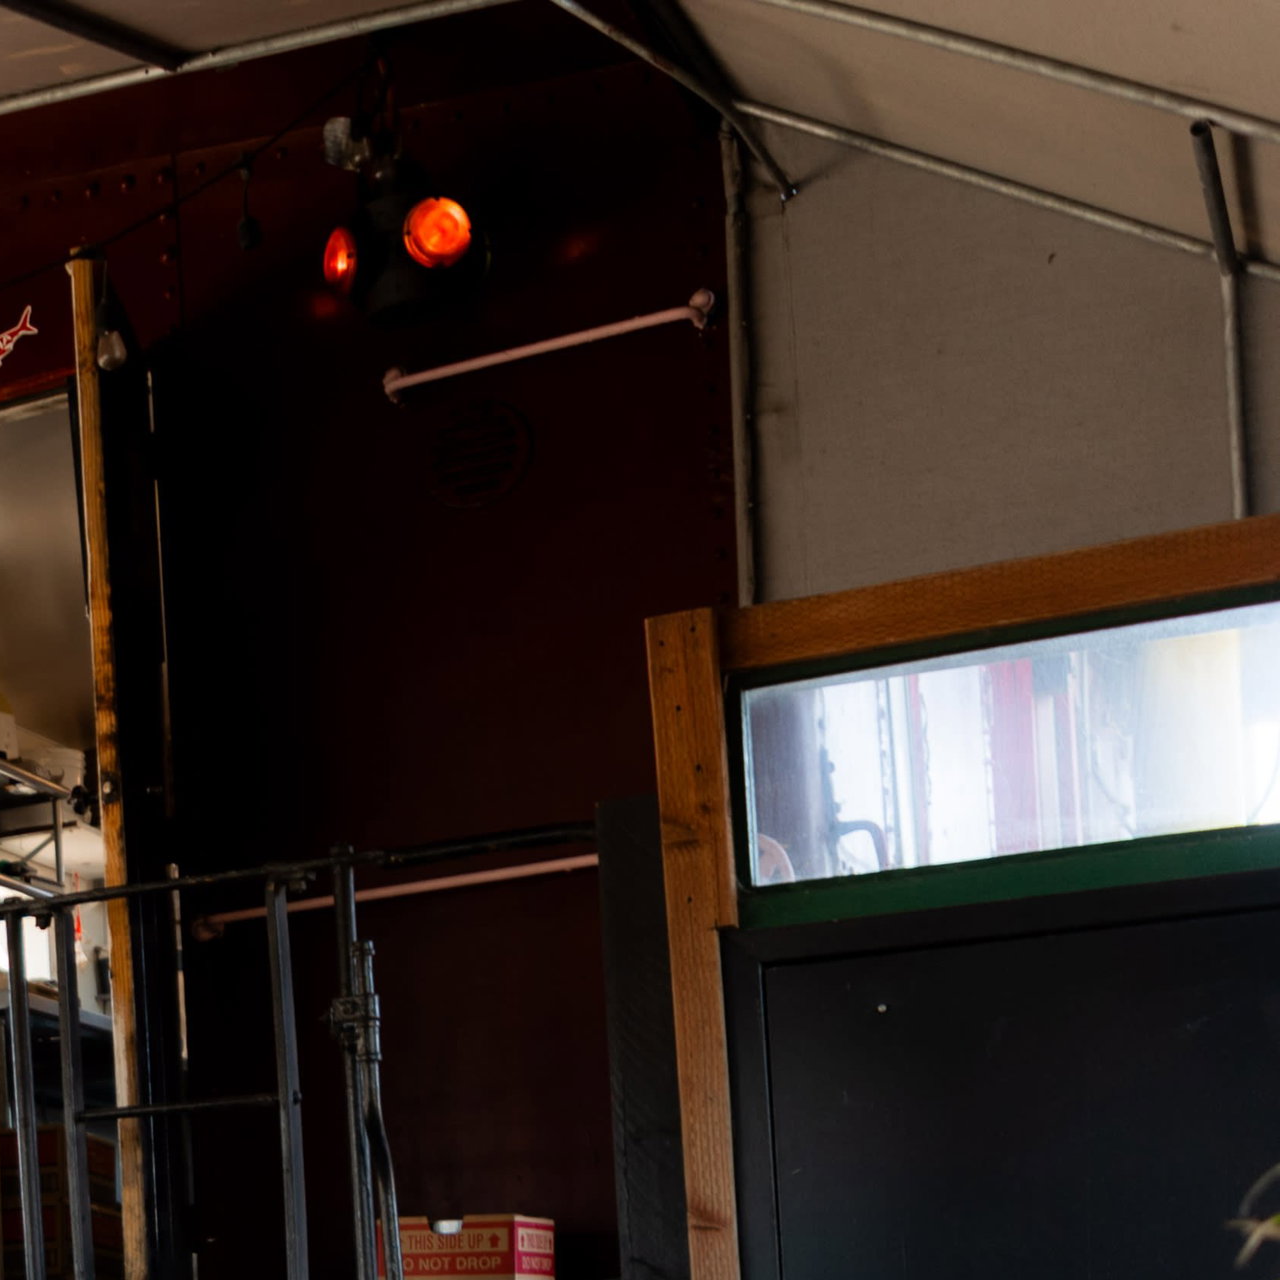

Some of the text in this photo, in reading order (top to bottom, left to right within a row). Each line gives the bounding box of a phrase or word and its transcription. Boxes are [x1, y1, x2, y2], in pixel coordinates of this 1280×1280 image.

[408, 1232, 484, 1250] THIS SIDE UP
[419, 1256, 451, 1271] NOT
[456, 1255, 501, 1270] DROP
